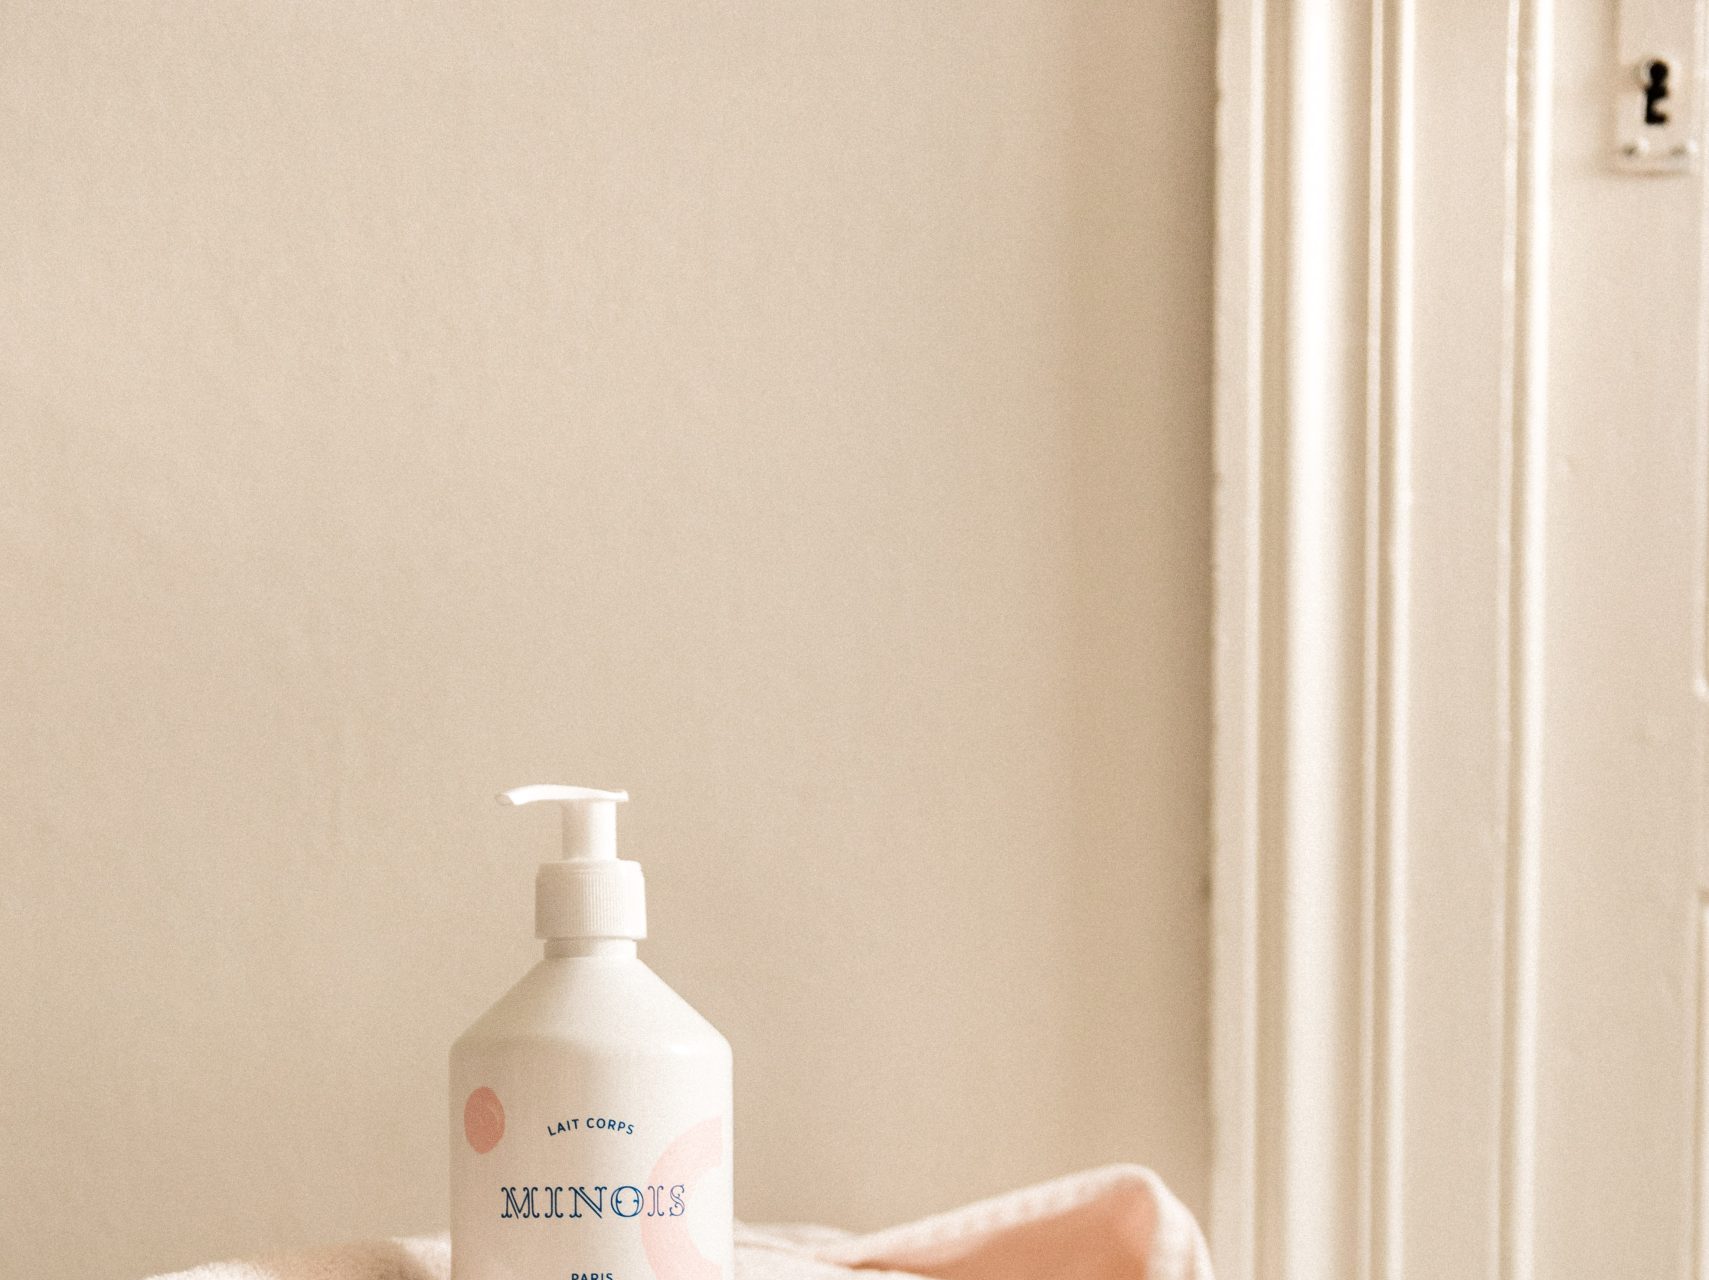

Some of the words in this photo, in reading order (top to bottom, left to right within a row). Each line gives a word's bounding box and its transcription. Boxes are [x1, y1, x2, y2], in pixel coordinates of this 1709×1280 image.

[547, 1118, 580, 1136] LAIT
[586, 1117, 635, 1135] CORPS
[500, 1184, 686, 1219] MINOIS
